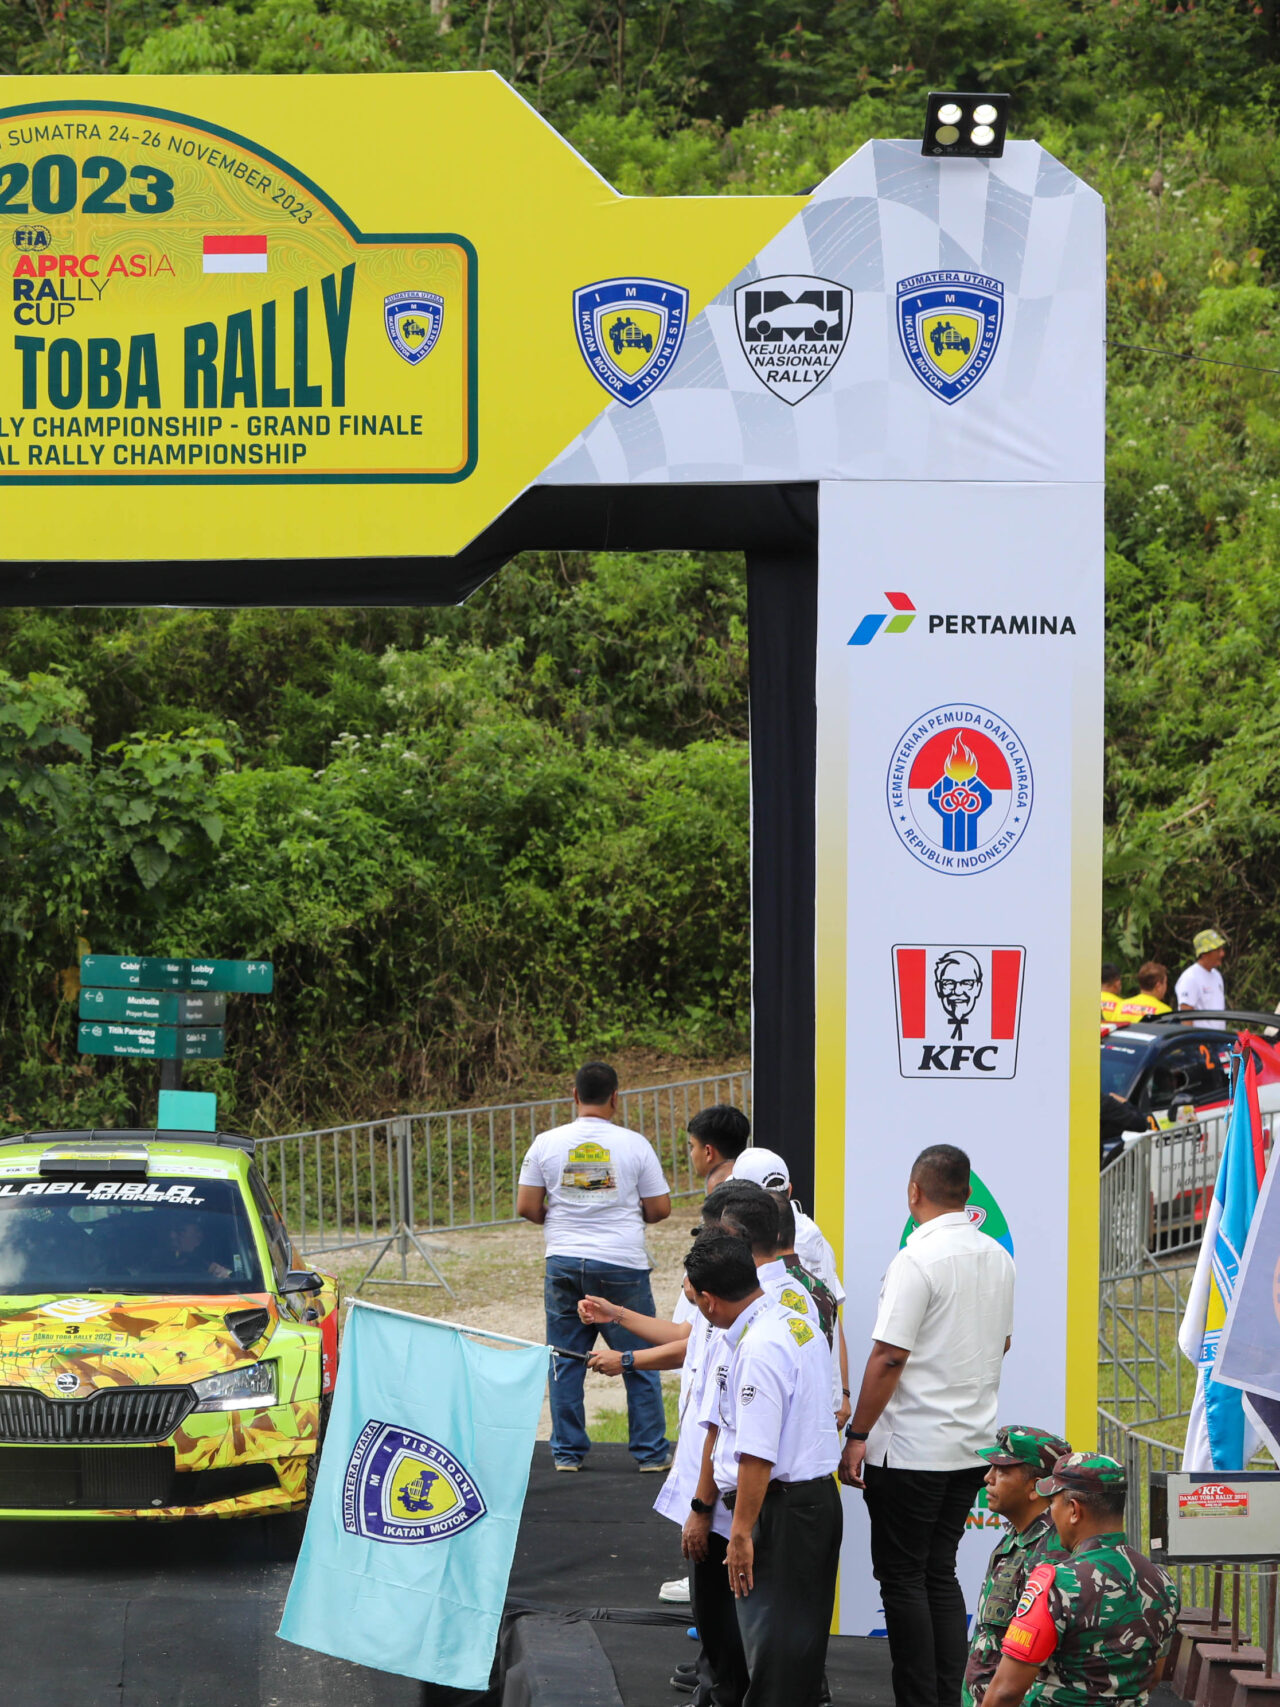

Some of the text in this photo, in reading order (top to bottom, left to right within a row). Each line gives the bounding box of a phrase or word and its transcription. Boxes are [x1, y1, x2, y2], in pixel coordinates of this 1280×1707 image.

[8, 123, 102, 146] SUMATRA
[109, 125, 161, 148] 24-26
[168, 136, 272, 193] NOVEMBER
[272, 188, 313, 224] 2023
[13, 254, 176, 278] APRC ASIA
[13, 278, 110, 301] RALLY
[901, 273, 999, 291] SUMATERA UTARA
[14, 302, 75, 326] CUP
[14, 333, 160, 410] TOBA
[183, 262, 356, 409] RALLY
[416, 315, 440, 358] INDONESIA
[582, 308, 681, 391] IKATAN MOTOR INDONESIA
[749, 344, 840, 355] KEJUARAAN
[754, 356, 832, 367] NASIONAL
[904, 314, 996, 390] IKATAN MOTOR INDONESIA
[766, 370, 825, 383] RALLY
[32, 416, 223, 438] CHAMPIONSHIP
[247, 415, 332, 437] GRAND
[340, 414, 423, 436] FINALE
[28, 444, 104, 466] RALLY
[113, 443, 307, 465] CHAMPIONSHIP
[929, 615, 1077, 635] PERTAMINA
[892, 711, 1028, 808] KEMENTERIAN PEMUDA DAN OLAHRAGA
[904, 828, 1016, 868] REPUBLIK INDONESIA
[191, 965, 214, 974] Lobby
[918, 1045, 998, 1071] KFC
[1199, 1045, 1215, 1070] 2
[86, 1193, 205, 1205] MOTORSPORT
[65, 1326, 80, 1334] 3
[346, 1424, 377, 1528] SUMATERA UTARA
[401, 1436, 474, 1500] INDONESIA
[1202, 1486, 1225, 1495] KFC
[383, 1511, 469, 1538] IKATAN MOTOR
